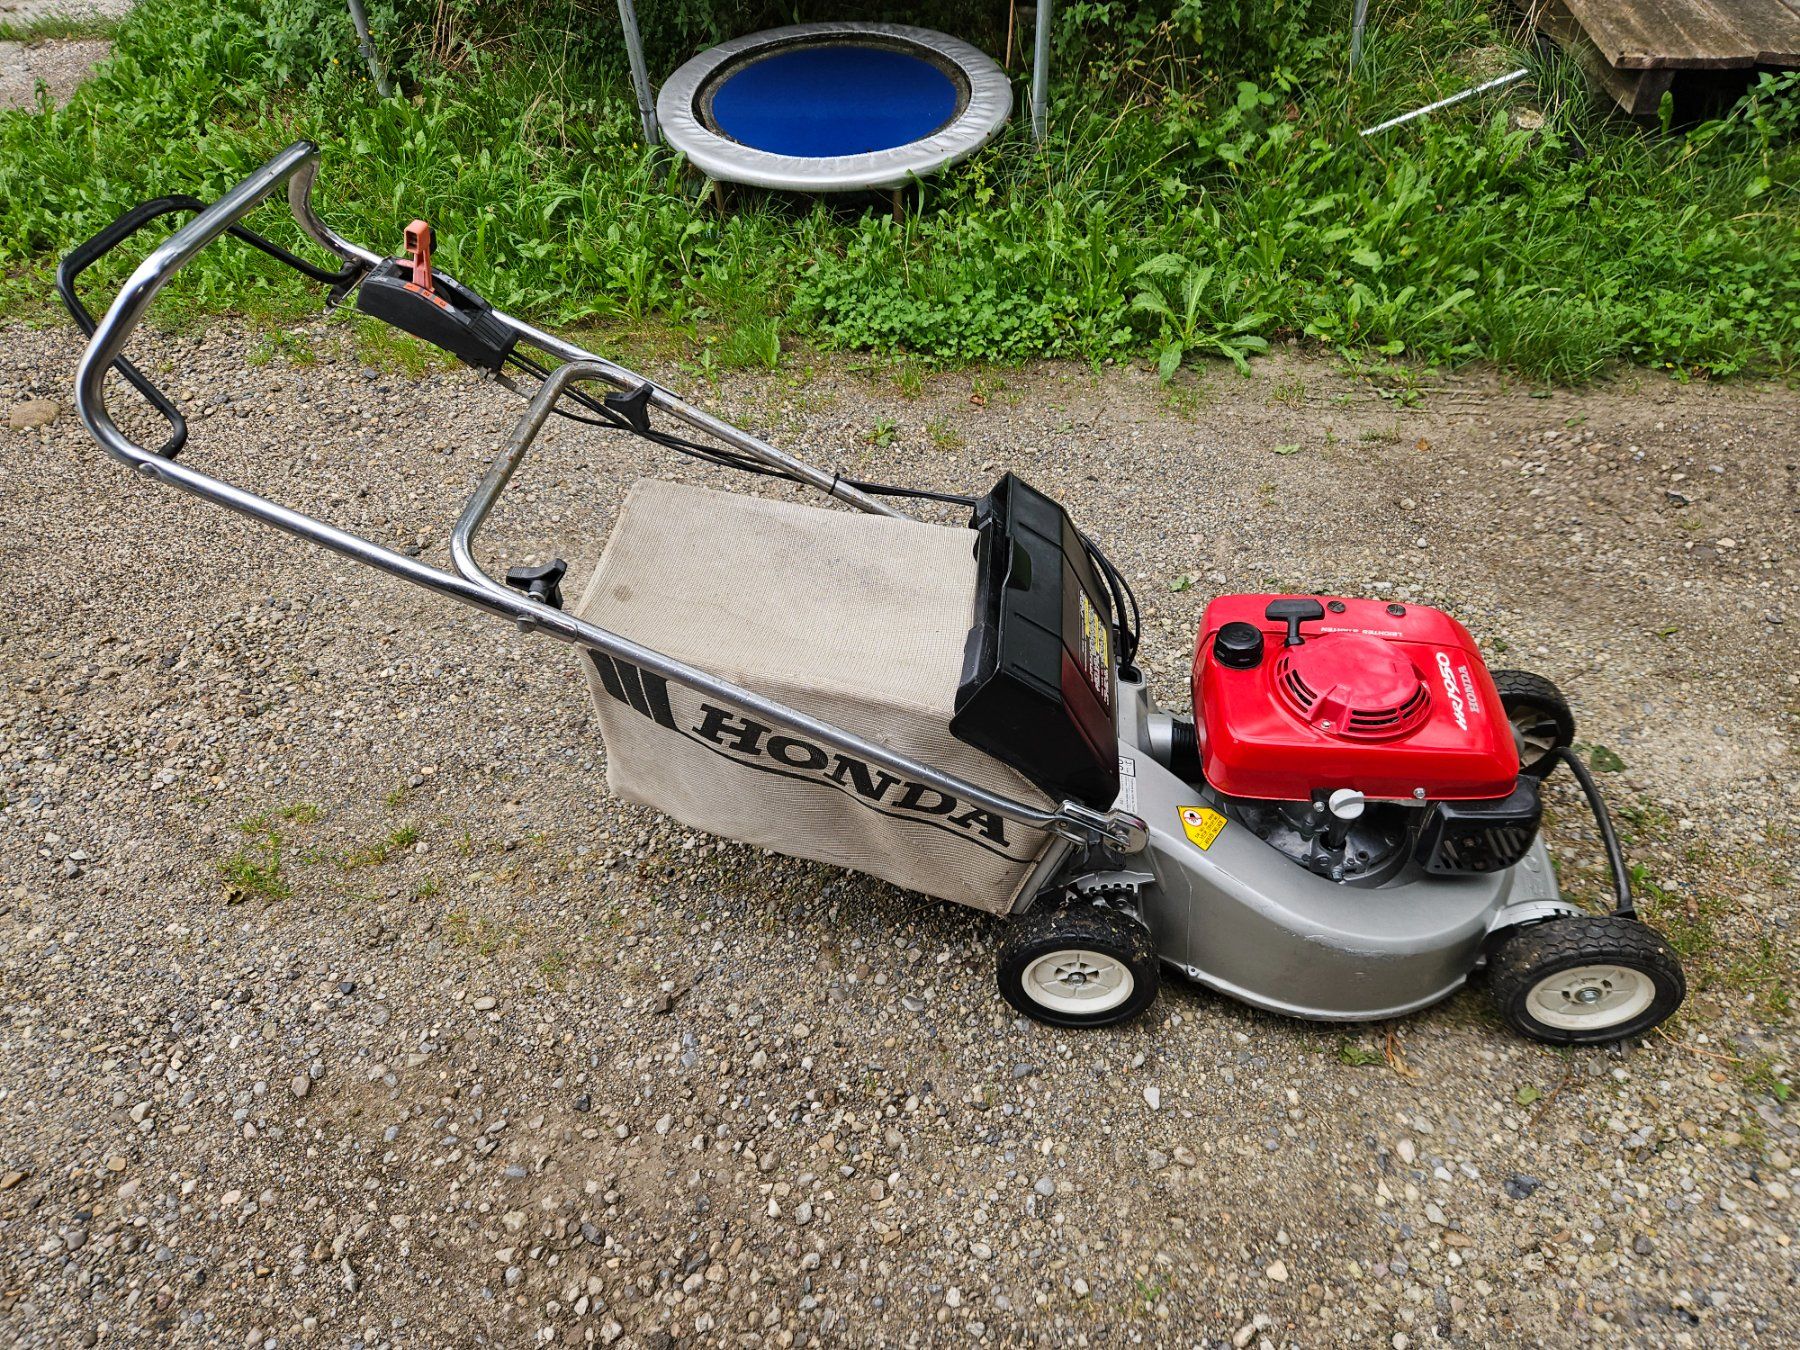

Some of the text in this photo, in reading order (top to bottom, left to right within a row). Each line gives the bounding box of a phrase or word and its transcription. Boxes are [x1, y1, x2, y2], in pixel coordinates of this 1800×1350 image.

[1362, 629, 1403, 637] LEICHTES
[1458, 665, 1480, 714] HONDA
[692, 703, 1011, 847] HONDA
